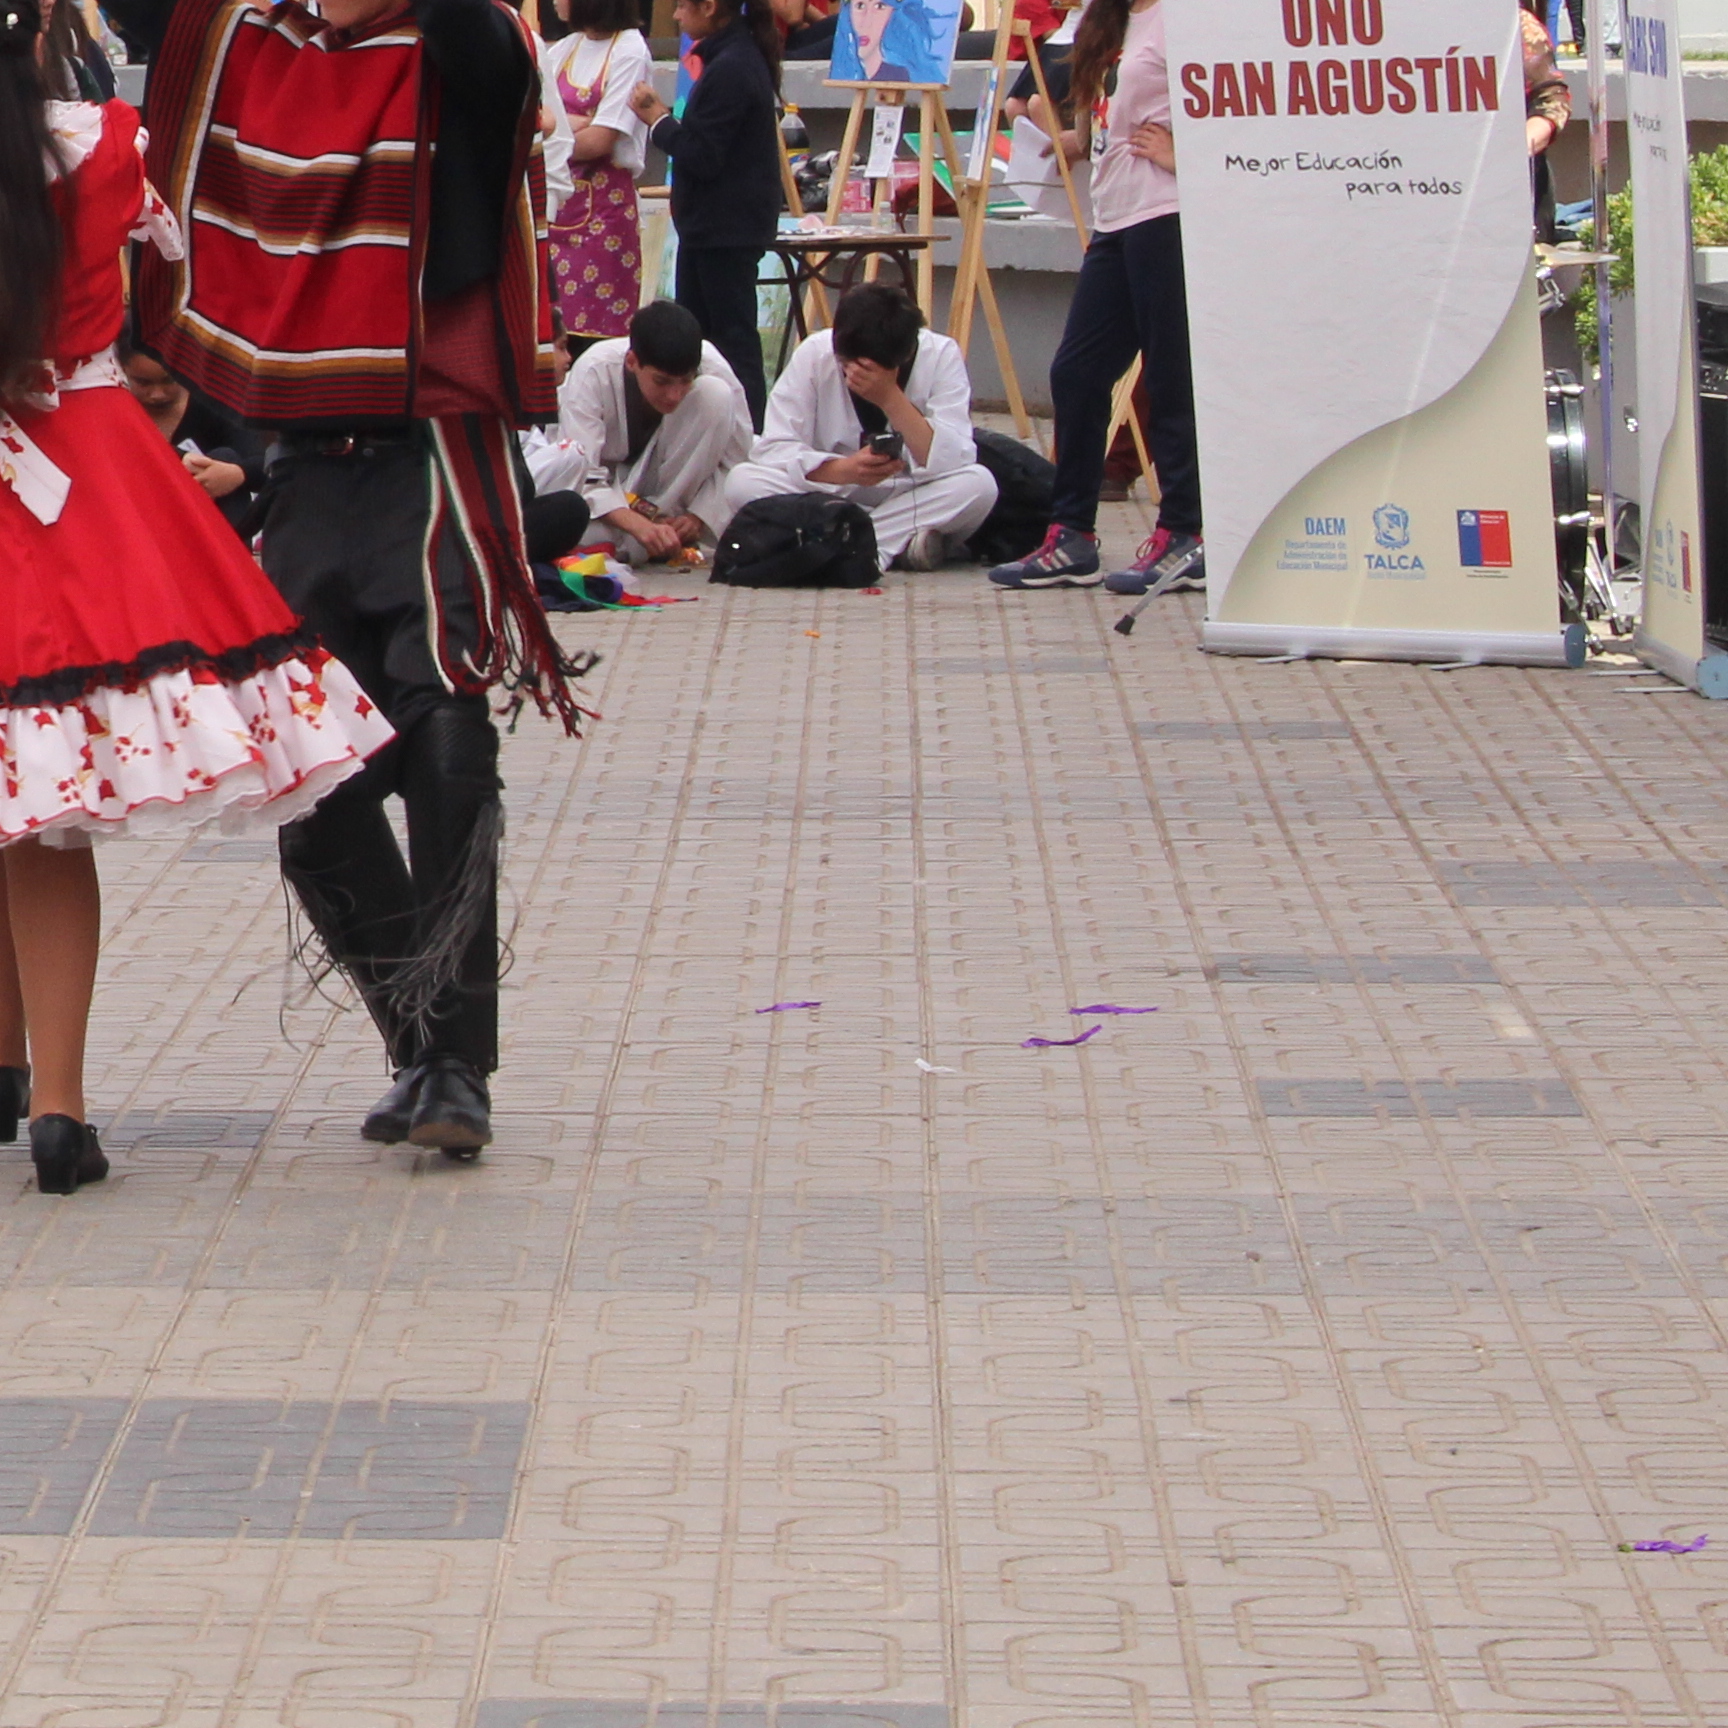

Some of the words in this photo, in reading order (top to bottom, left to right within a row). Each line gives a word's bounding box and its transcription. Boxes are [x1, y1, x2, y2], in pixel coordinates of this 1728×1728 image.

[1181, 61, 1276, 118] SAN
[1287, 46, 1499, 116] AGUSTÍN
[1225, 155, 1290, 176] Mejor
[1296, 150, 1403, 172] Educación
[1346, 181, 1403, 200] para
[1408, 176, 1463, 195] todos
[1305, 517, 1346, 535] DAEM
[1364, 554, 1425, 570] TALCA
